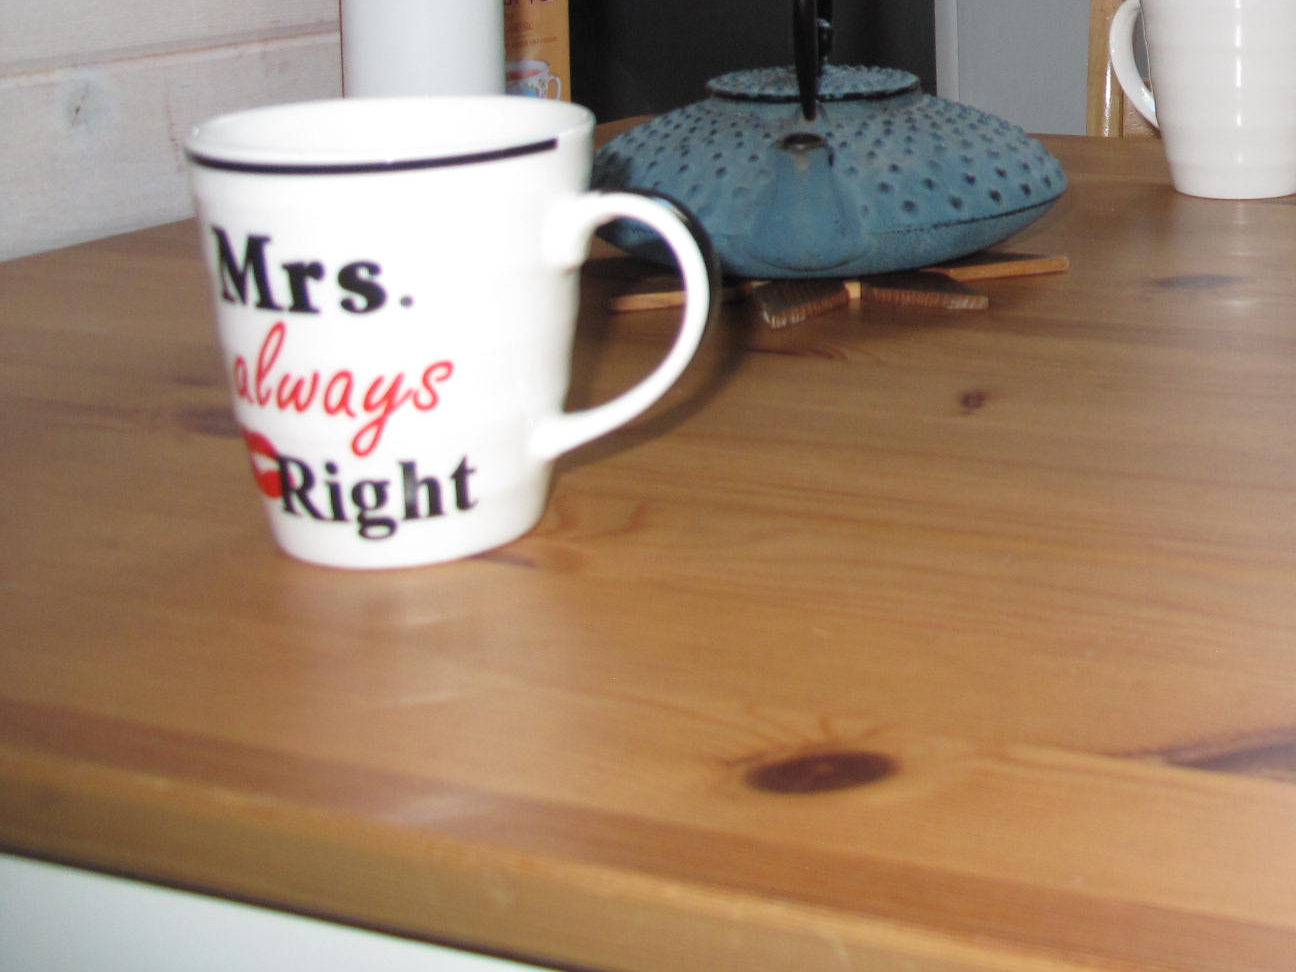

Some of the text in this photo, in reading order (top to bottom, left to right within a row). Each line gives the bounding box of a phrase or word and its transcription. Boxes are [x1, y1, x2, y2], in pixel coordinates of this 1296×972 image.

[211, 224, 414, 314] Mrs.
[234, 321, 454, 457] always
[276, 454, 479, 539] Right
